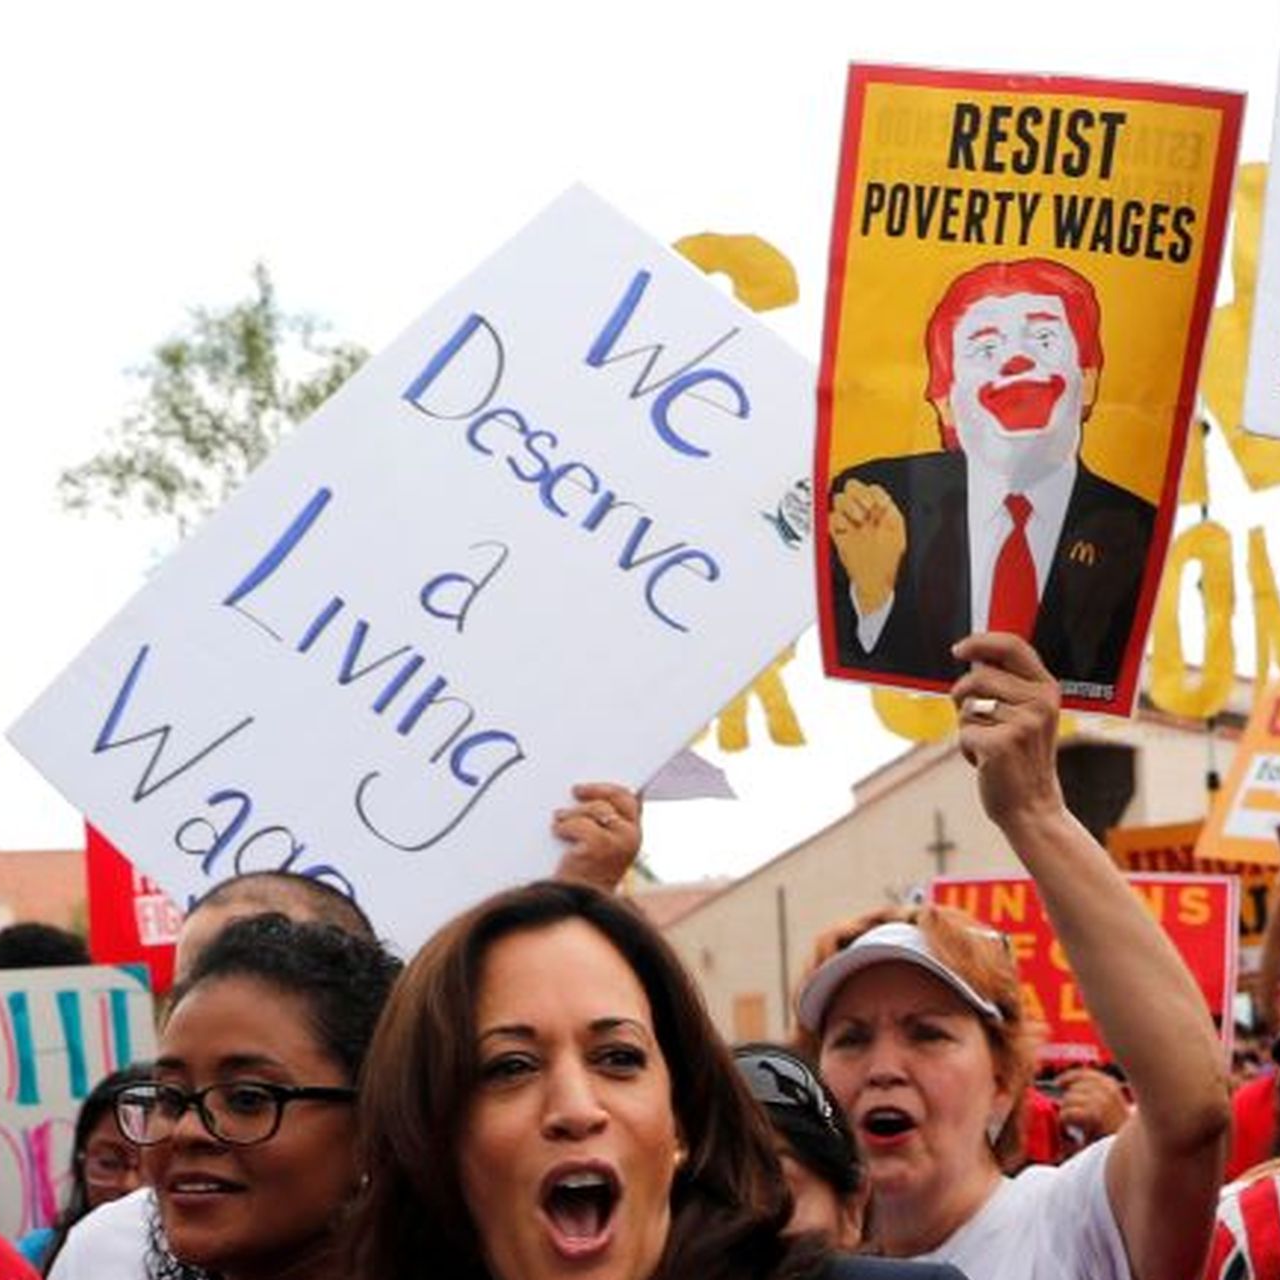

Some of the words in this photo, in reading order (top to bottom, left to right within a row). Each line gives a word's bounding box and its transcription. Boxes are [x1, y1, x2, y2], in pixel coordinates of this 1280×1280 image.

[947, 102, 1126, 181] RESIST
[861, 182, 1049, 248] POVERTY
[1053, 193, 1196, 264] WAGES
[585, 270, 750, 458] We
[401, 312, 721, 632] Deserve
[420, 540, 509, 633] a
[223, 486, 526, 852] Living
